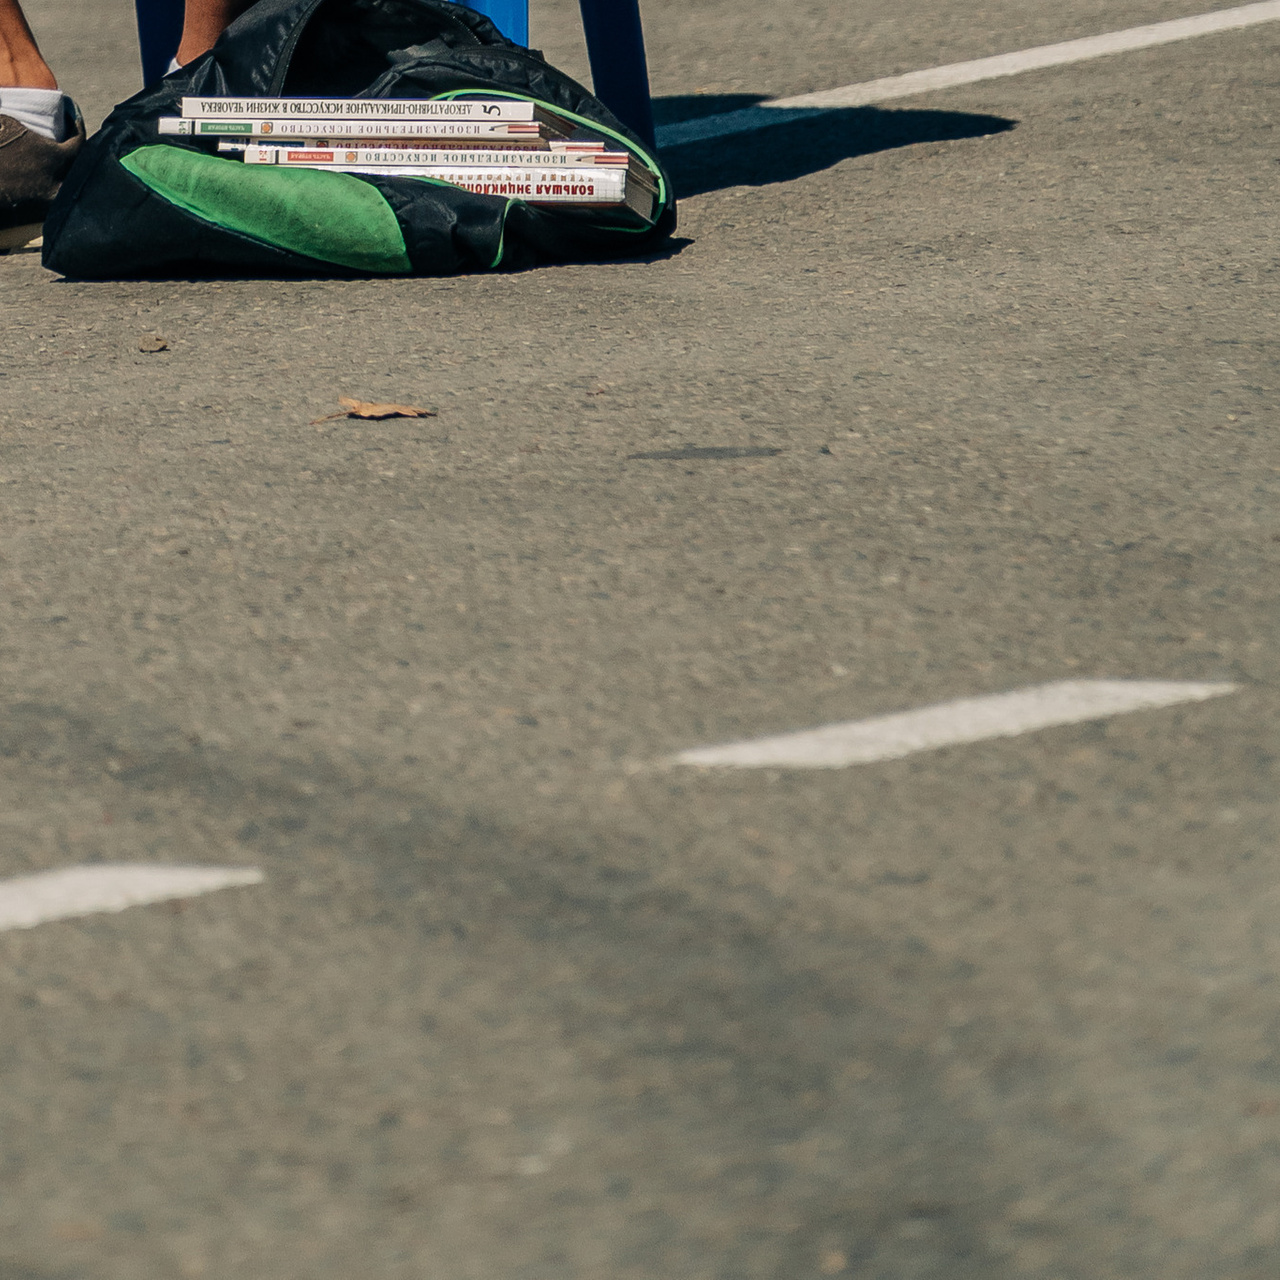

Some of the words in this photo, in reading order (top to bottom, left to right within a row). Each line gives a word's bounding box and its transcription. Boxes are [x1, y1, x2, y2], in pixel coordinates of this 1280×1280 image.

[200, 102, 244, 114] ЧЕЛОВЕКА
[246, 102, 280, 114] ЖИЗНИ
[282, 102, 288, 113] В
[290, 101, 343, 115] ИСКУССТВО
[345, 103, 473, 116] ДЕКОРАТИВНО-ПРИКЛАДНОЕ
[281, 124, 352, 134] ИСКУССТВО
[358, 125, 480, 134] ИЗОБРАЗИТЕЛЬНОЕ
[365, 153, 437, 162] ИСКУССТВО
[443, 154, 567, 164] ИЗОБРАЗИТЕЛЬНОЕ
[536, 184, 594, 196] БОЛЬШАЯ
